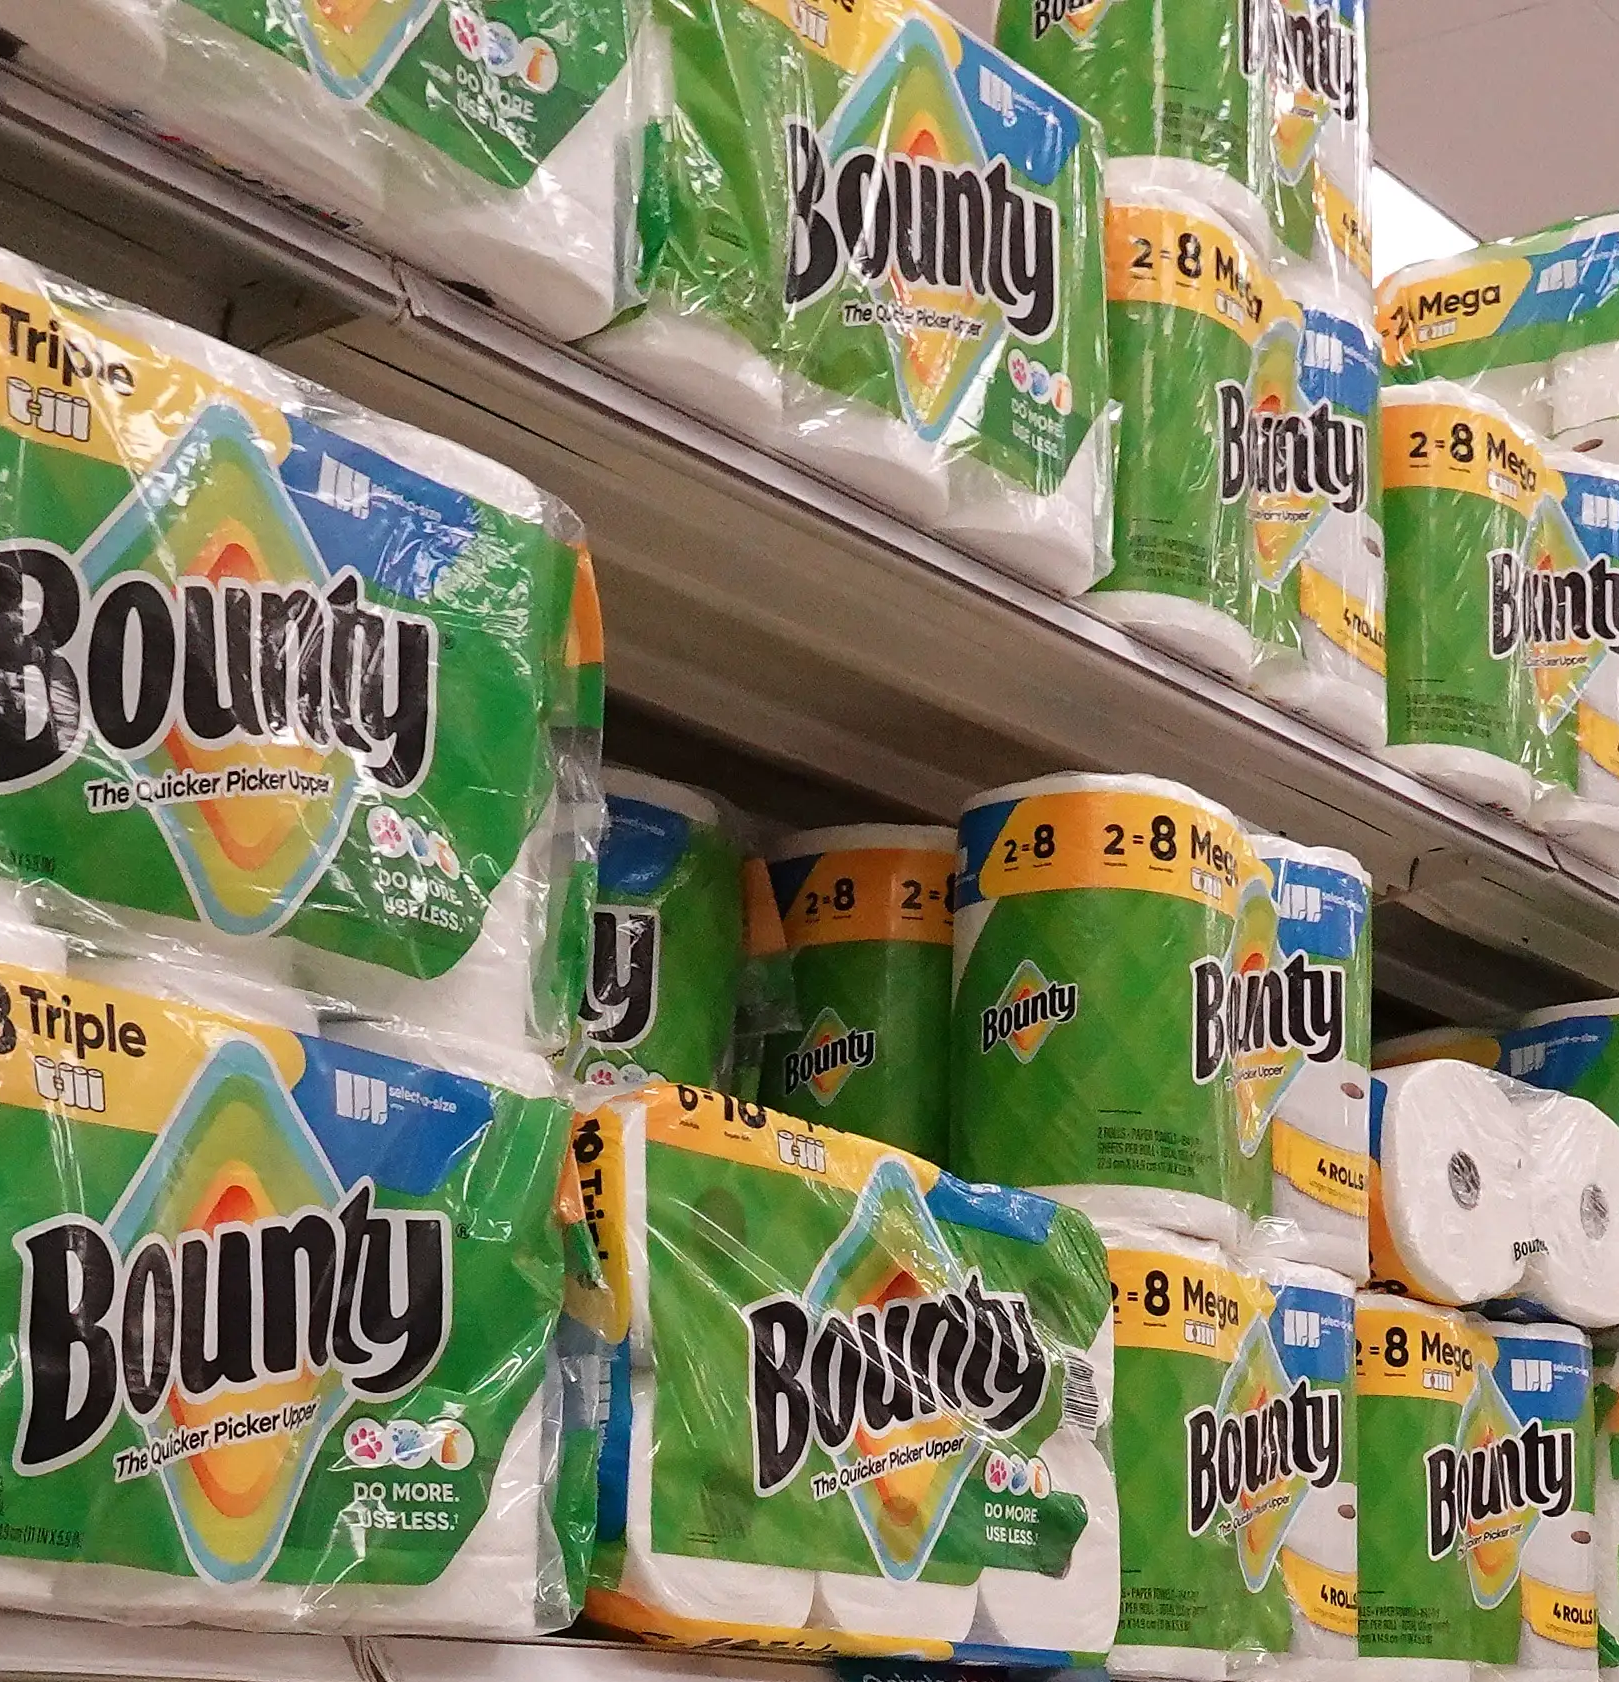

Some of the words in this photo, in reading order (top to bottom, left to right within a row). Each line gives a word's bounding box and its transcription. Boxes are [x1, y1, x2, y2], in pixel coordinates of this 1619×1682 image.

[787, 123, 1054, 337] Bounty
[844, 304, 873, 324] The
[1419, 283, 1502, 319] Mega
[0, 301, 135, 398] Triple
[1487, 433, 1537, 492] Mega
[88, 783, 131, 808] The
[136, 777, 219, 803] Quicker
[226, 769, 284, 794] Picker
[289, 770, 332, 796] Upper
[21, 984, 147, 1056] Triple
[983, 982, 1078, 1053] Bounty
[1194, 952, 1343, 1084] Bounty
[787, 1025, 875, 1095] Bounty
[388, 1084, 458, 1115] select-a-size
[1331, 1165, 1364, 1191] ROLLS
[21, 1185, 444, 1466] Bounty
[1183, 1279, 1240, 1329] Mega
[1422, 1330, 1473, 1374] Mega
[750, 1282, 1046, 1490] Bounty
[116, 1450, 149, 1481] The
[151, 1430, 209, 1469] Quicker
[213, 1414, 281, 1448] Picker
[283, 1402, 317, 1435] Upper
[814, 1476, 837, 1497] The
[840, 1456, 886, 1490] Quicker
[889, 1444, 925, 1478] Picker
[926, 1434, 965, 1469] Upper
[1188, 1380, 1341, 1532] Bounty
[353, 1482, 386, 1504] DO
[392, 1483, 461, 1506] MORE.
[985, 1504, 1001, 1523] DO
[1006, 1507, 1040, 1525] MORE.
[1429, 1420, 1572, 1558] Bounty
[357, 1509, 394, 1530] USE
[986, 1526, 1007, 1545] USE
[1565, 1605, 1594, 1625] ROLLS
